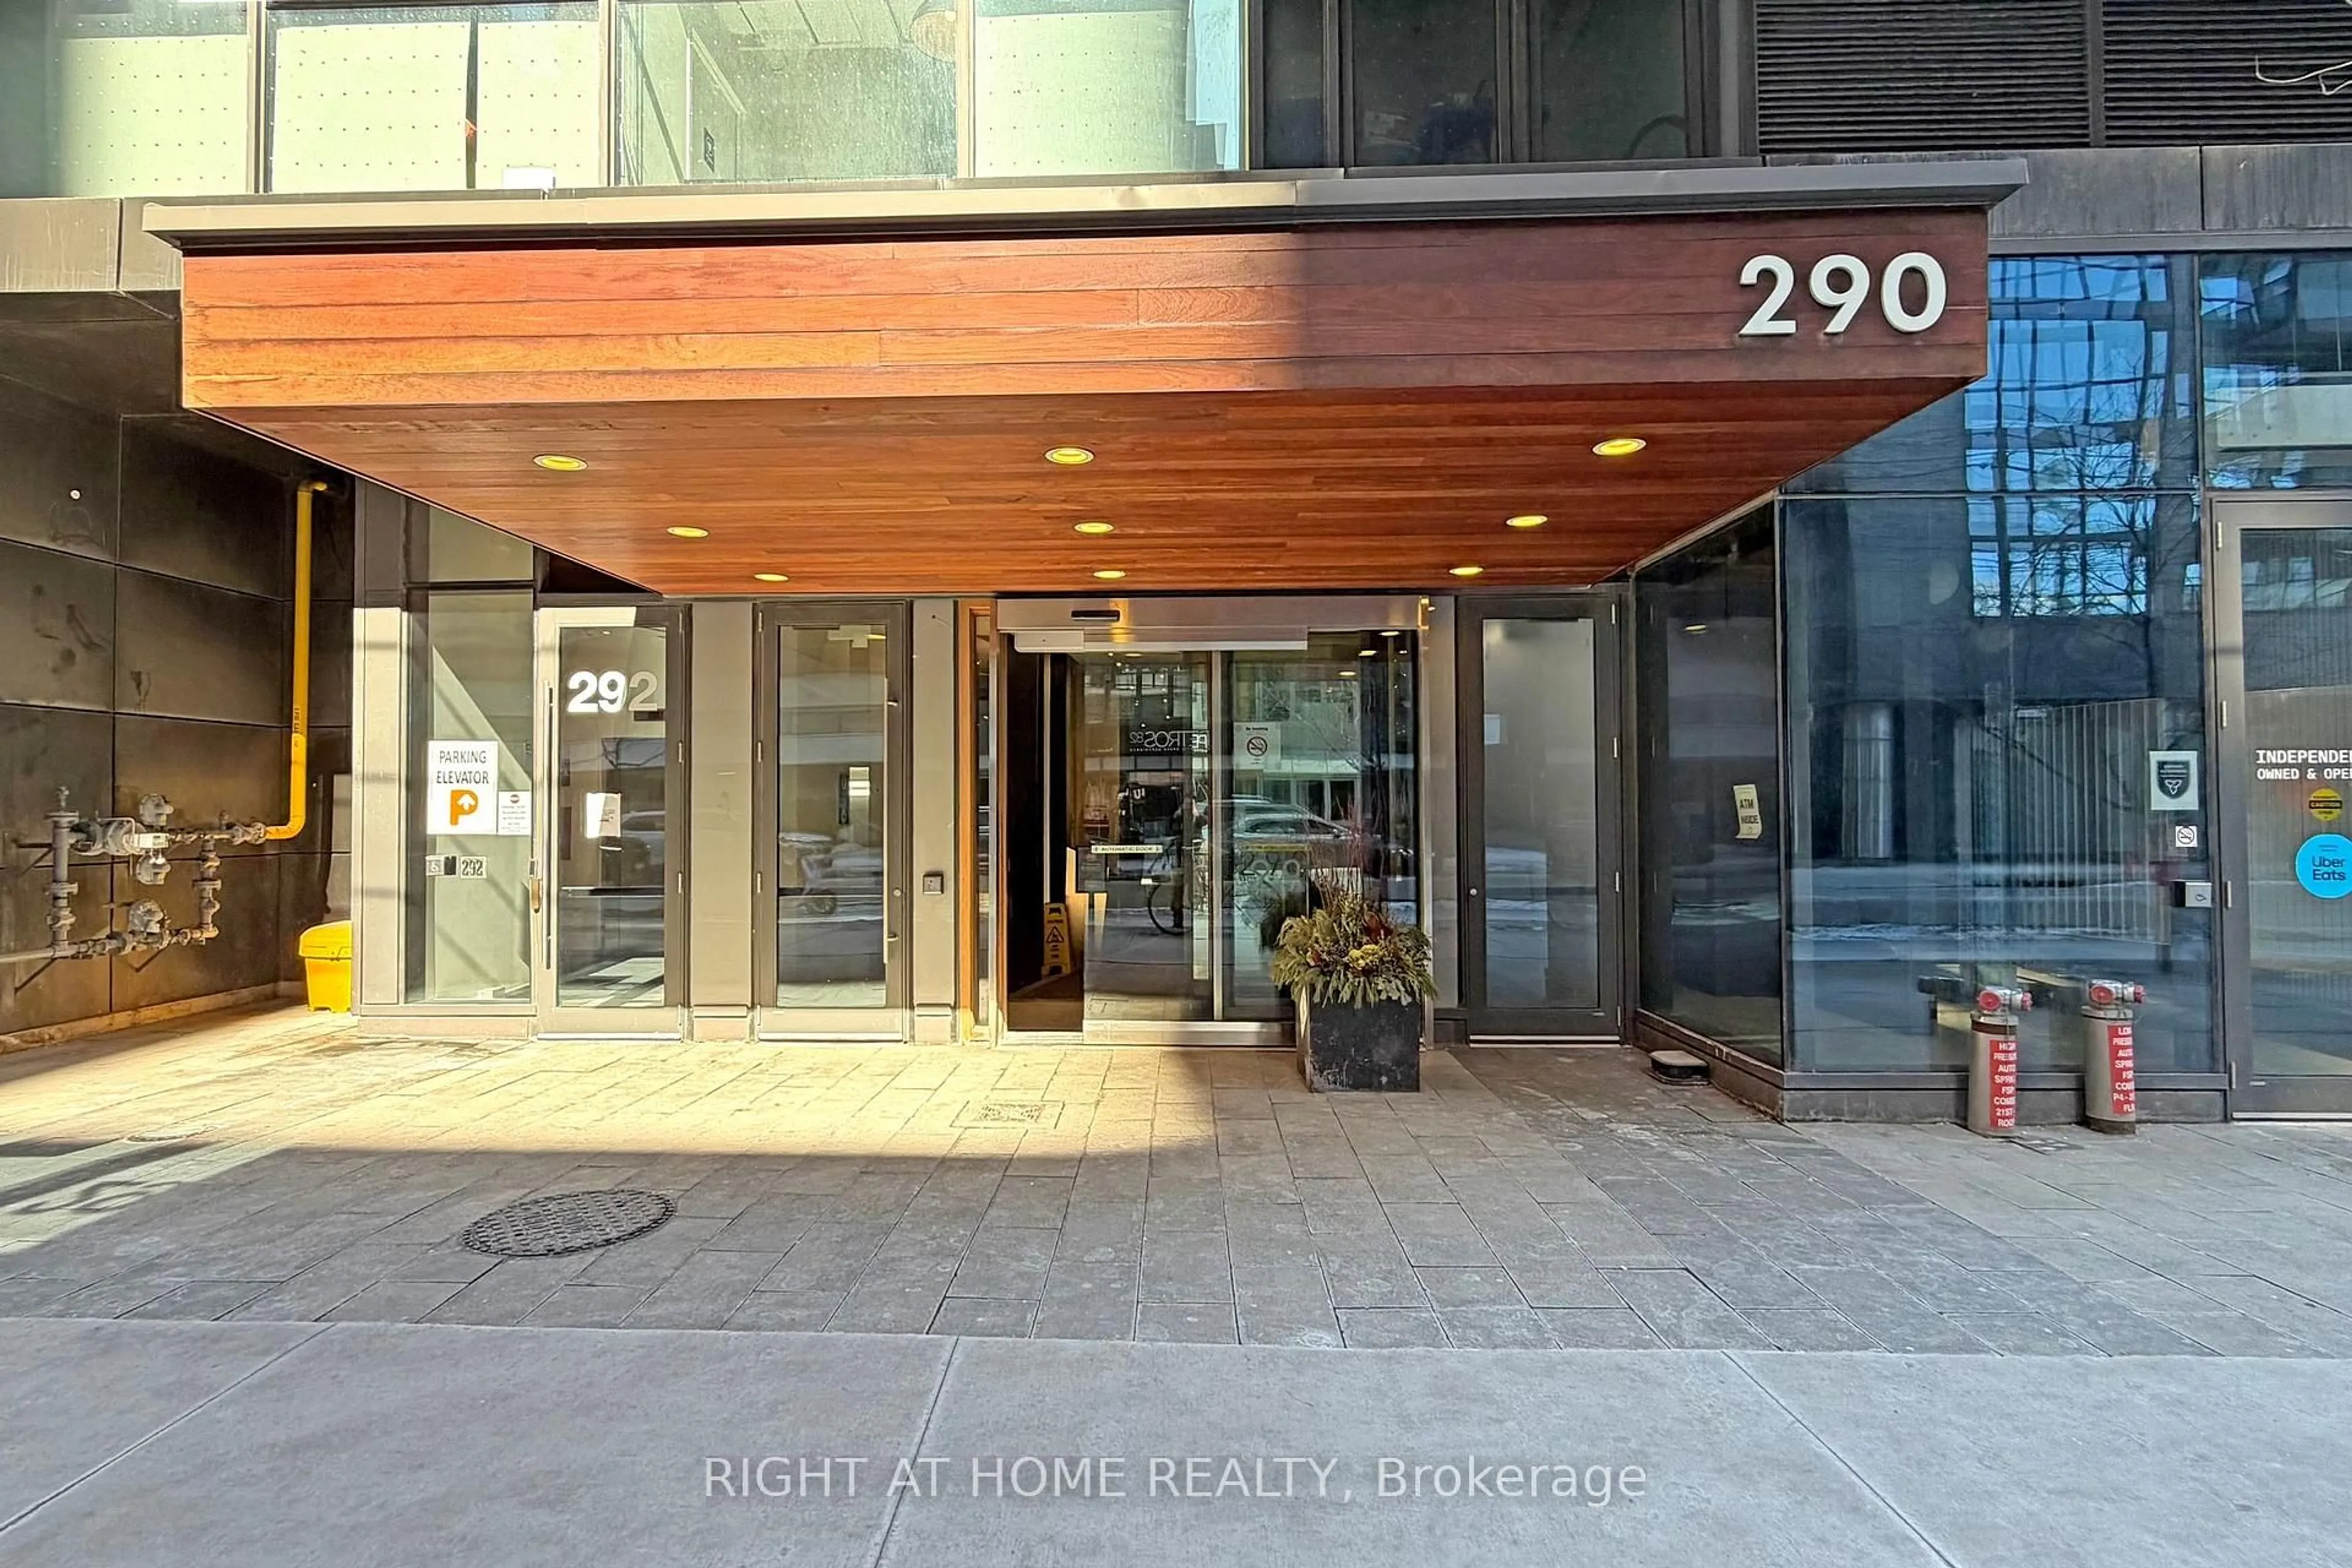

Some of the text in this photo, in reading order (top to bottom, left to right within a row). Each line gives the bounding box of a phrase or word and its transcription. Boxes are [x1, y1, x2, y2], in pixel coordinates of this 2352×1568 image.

[1738, 252, 1947, 336] 290
[567, 671, 658, 713] 292
[439, 750, 488, 764] PARKING
[2255, 750, 2352, 764] INDEPENDE
[435, 771, 489, 784] ELEVATOR
[2256, 768, 2352, 780] OWNED & OPE
[1740, 798, 1754, 809] ATM
[462, 859, 483, 876] 292
[2312, 856, 2346, 868] Uber
[2313, 869, 2346, 881] Eats
